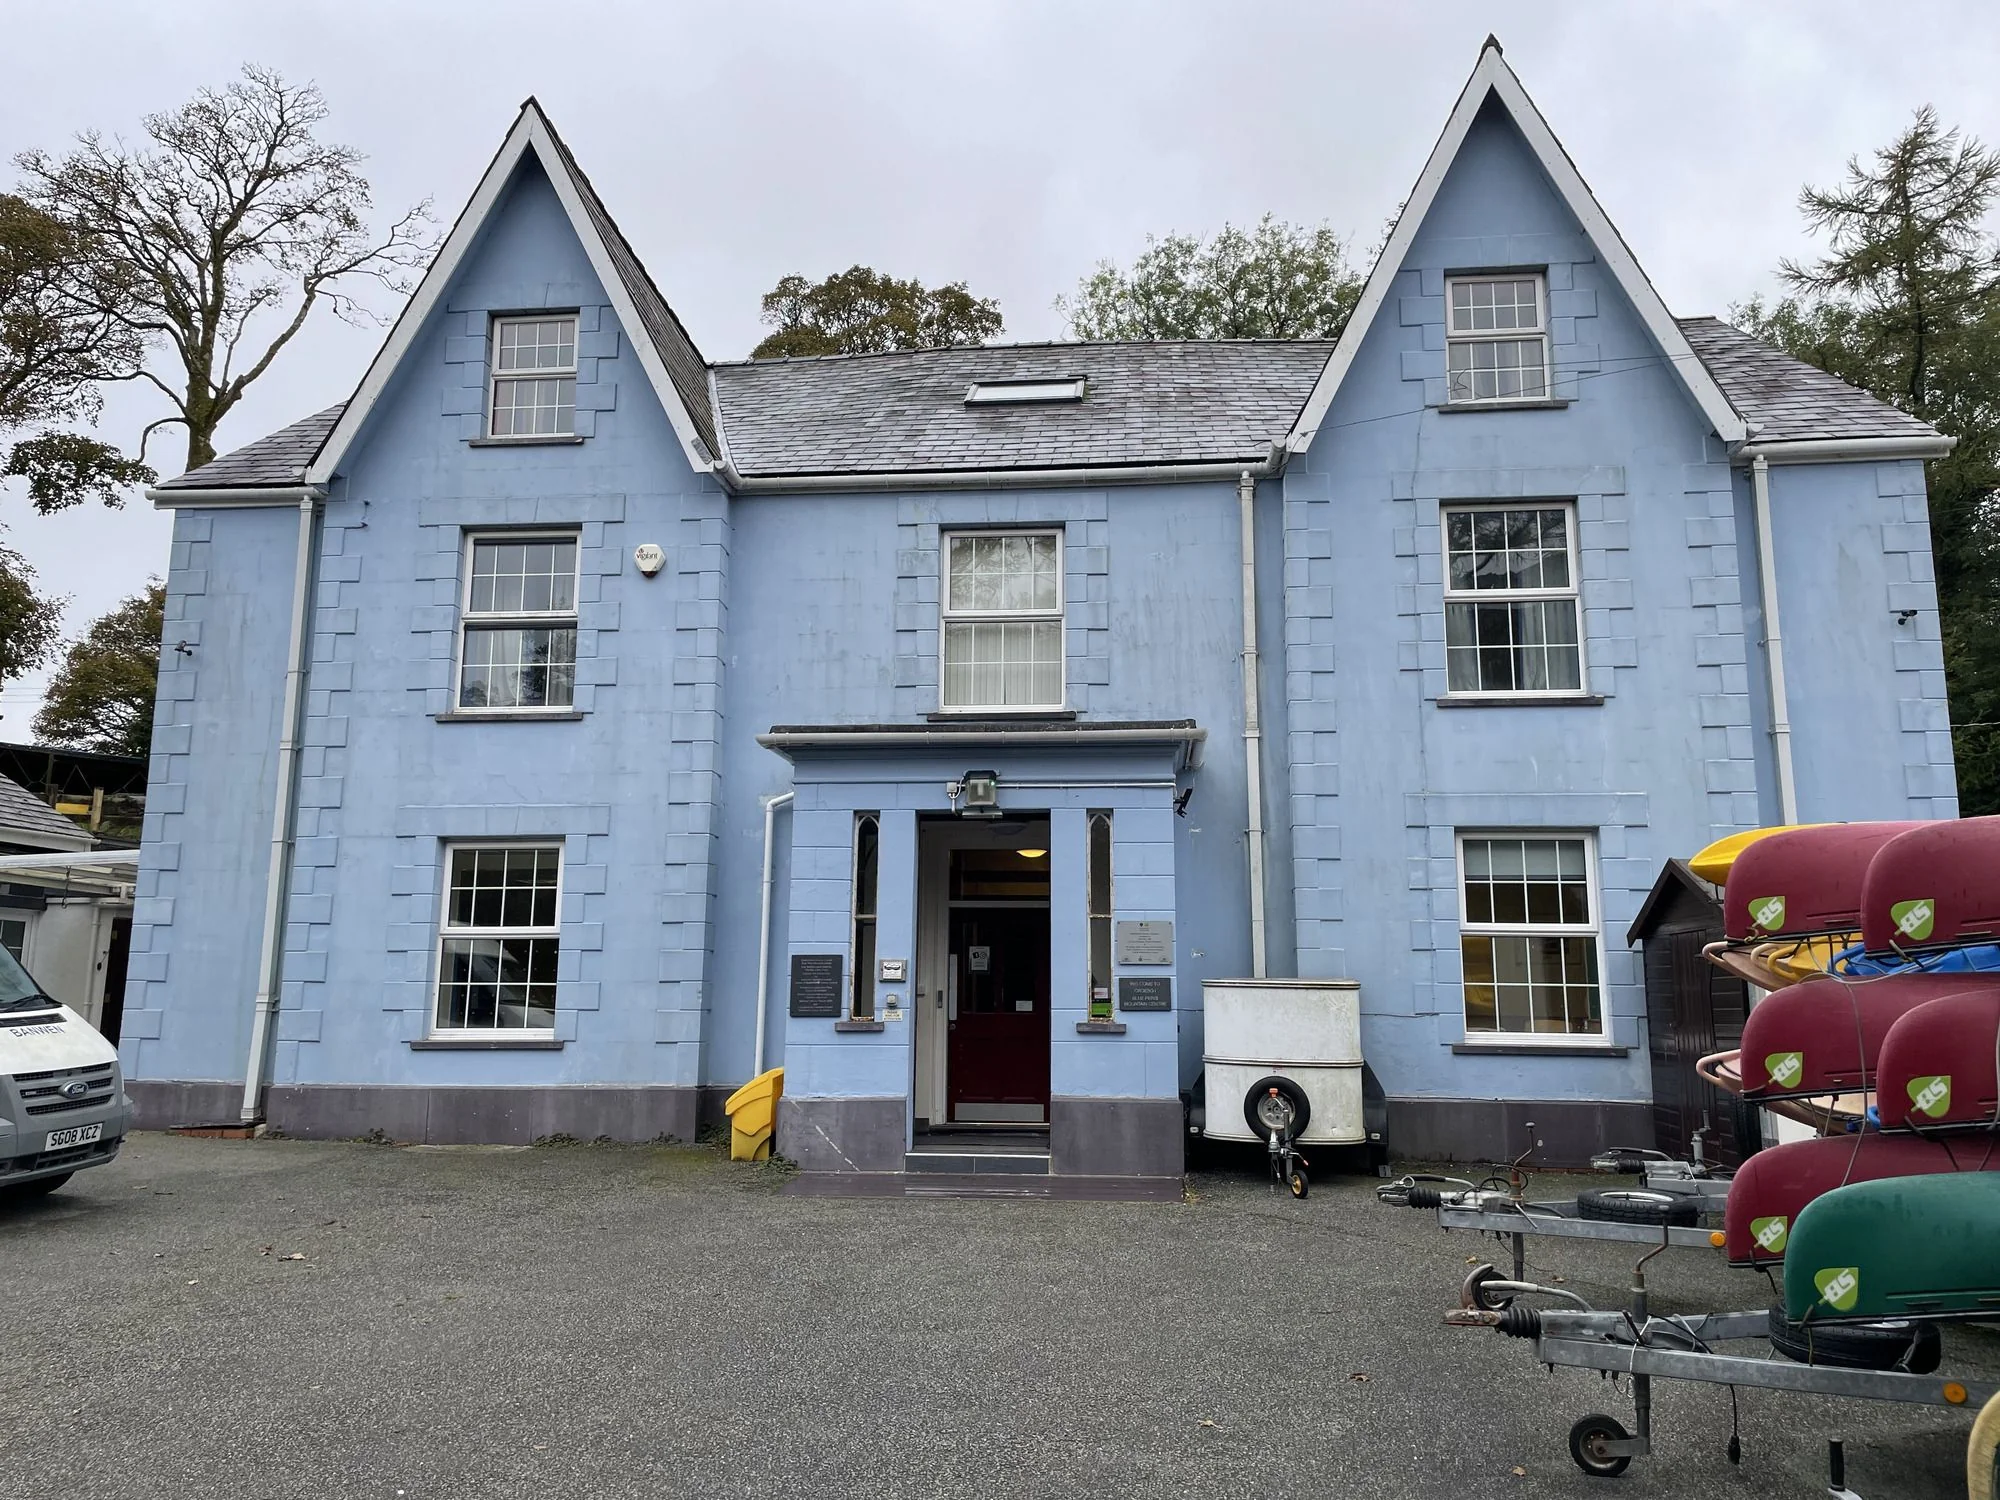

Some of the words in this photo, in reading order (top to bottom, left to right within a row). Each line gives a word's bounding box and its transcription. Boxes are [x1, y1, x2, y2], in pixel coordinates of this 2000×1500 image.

[10, 1024, 65, 1038] BANWEN
[71, 1085, 85, 1095] Ford
[51, 1130, 77, 1147] SG08
[78, 1125, 99, 1142] XCZ
